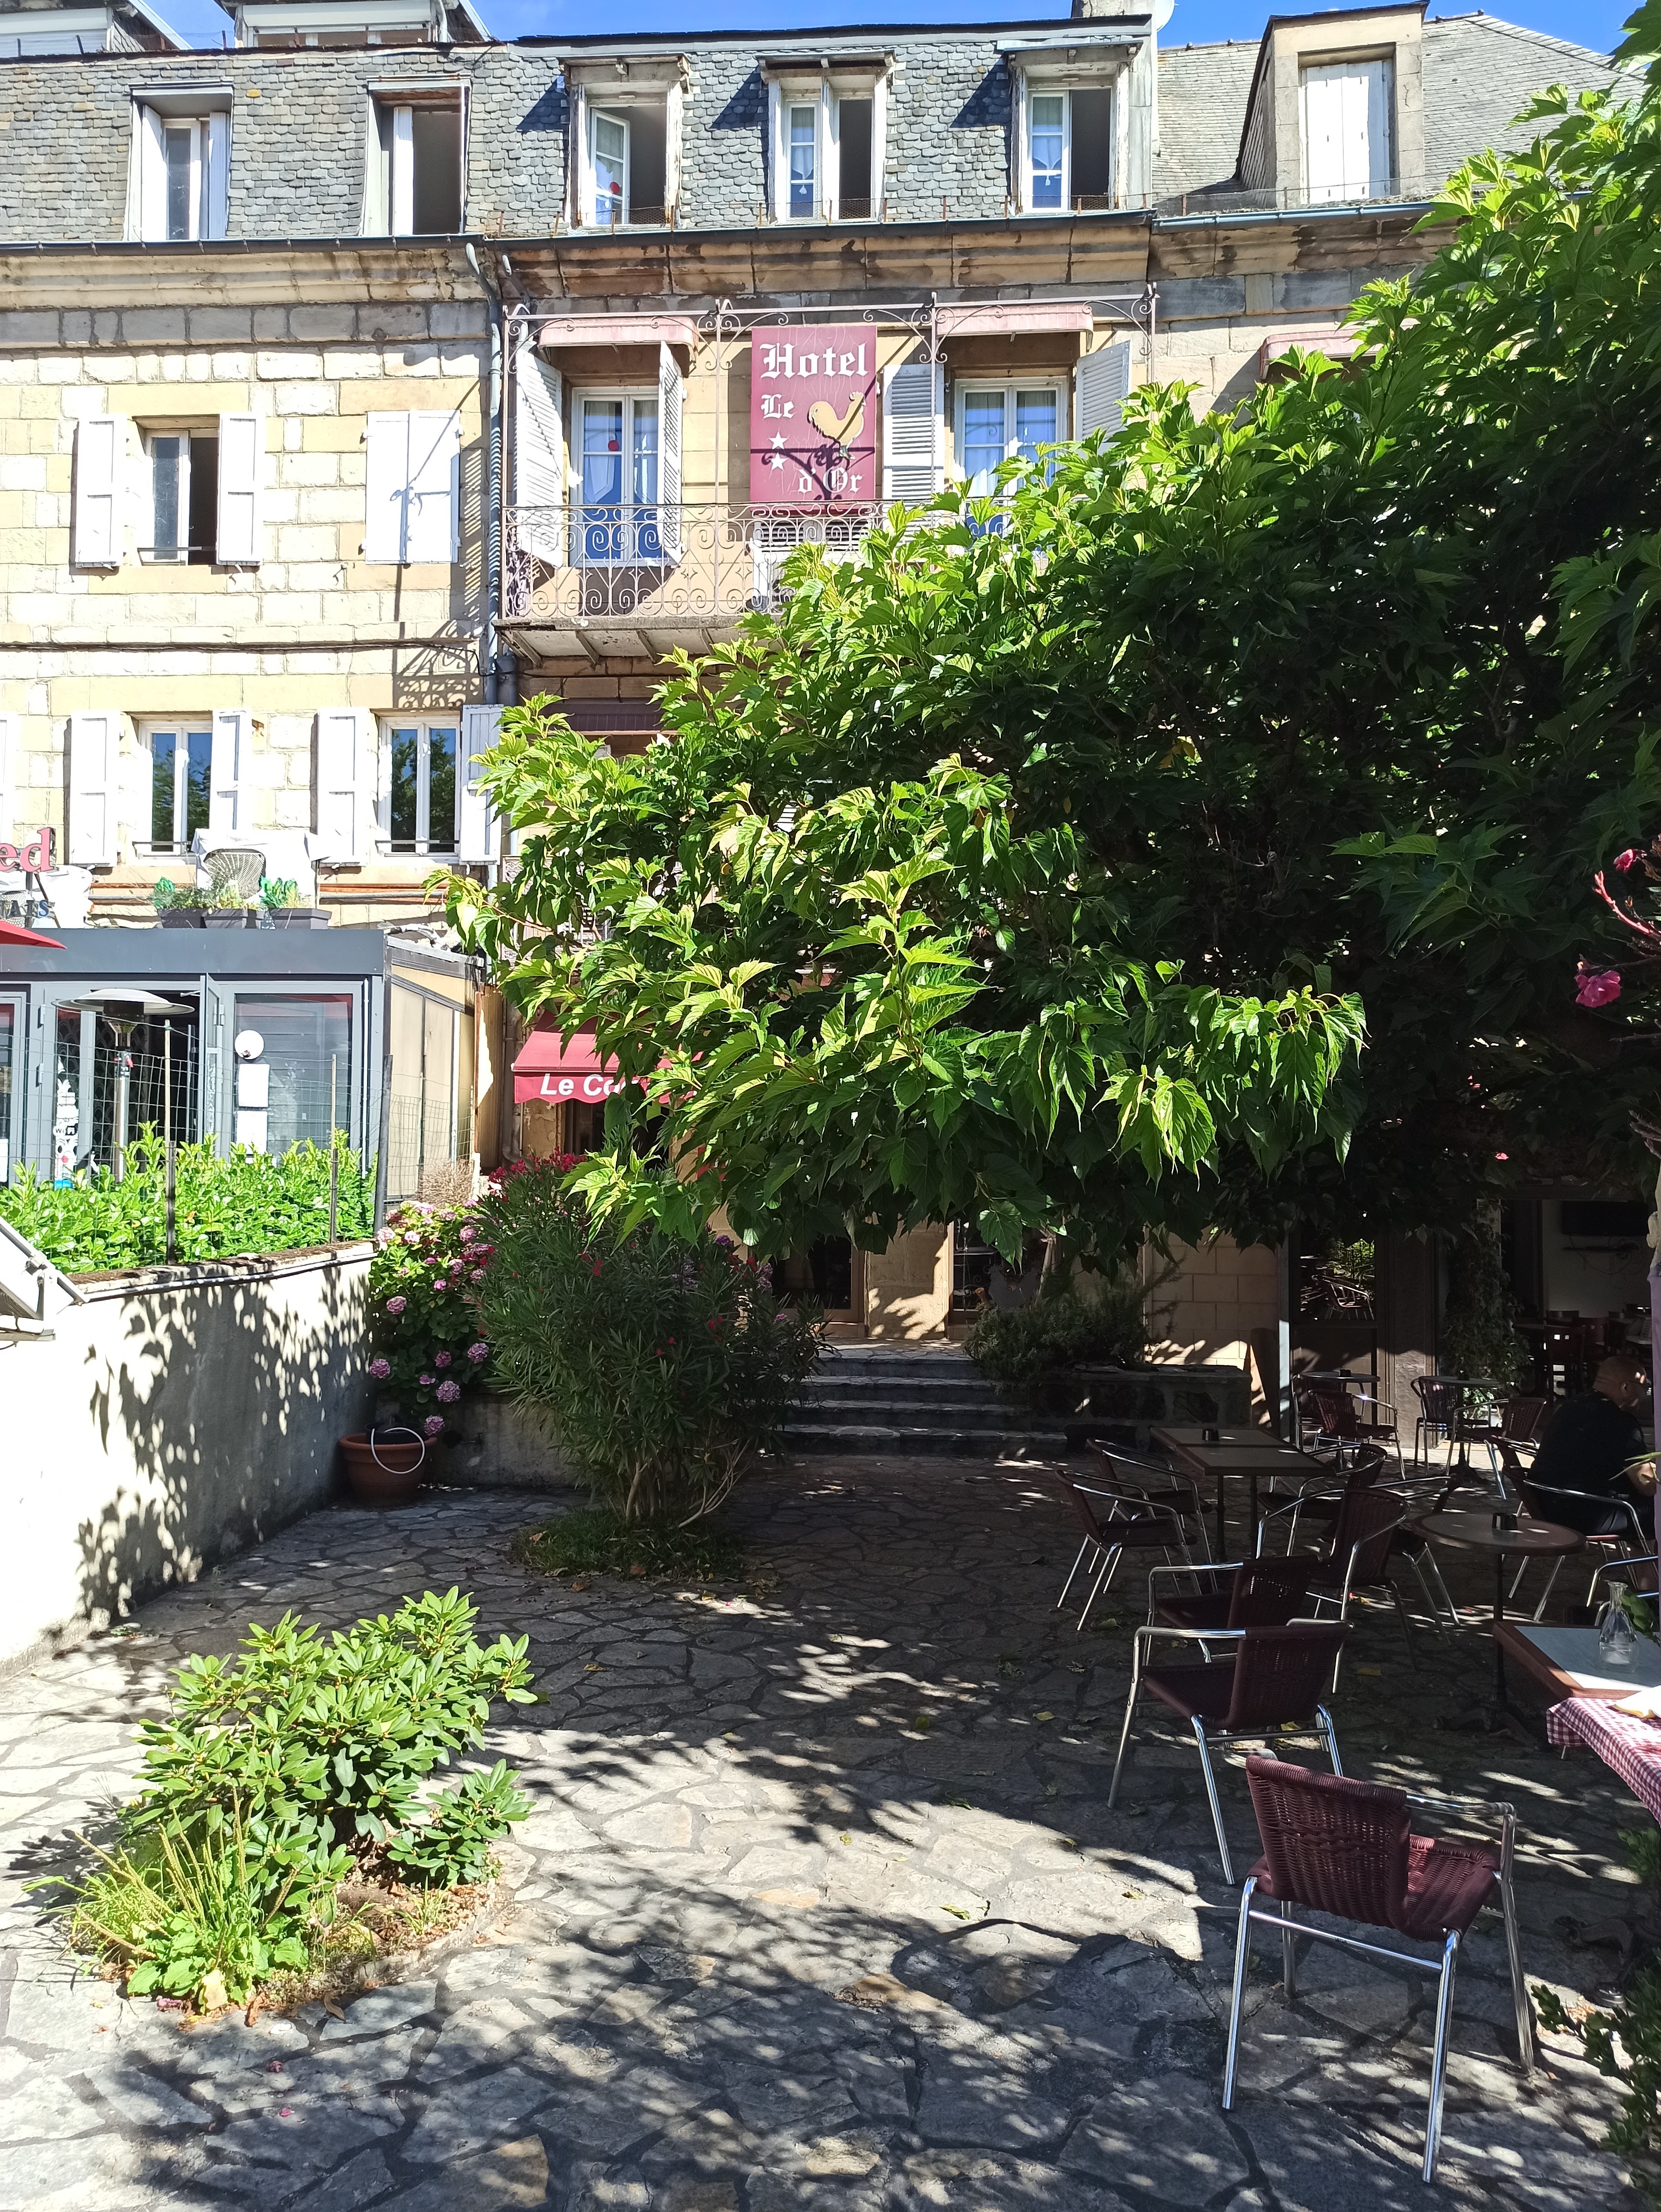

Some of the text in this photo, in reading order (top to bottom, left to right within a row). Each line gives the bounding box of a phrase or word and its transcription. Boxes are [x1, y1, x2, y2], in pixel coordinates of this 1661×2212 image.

[760, 343, 868, 379] Hotel
[761, 394, 794, 419] Le
[798, 467, 863, 494] d'Or
[0, 899, 49, 918] AIS
[540, 1073, 574, 1096] Le
[583, 1074, 639, 1096] Co
